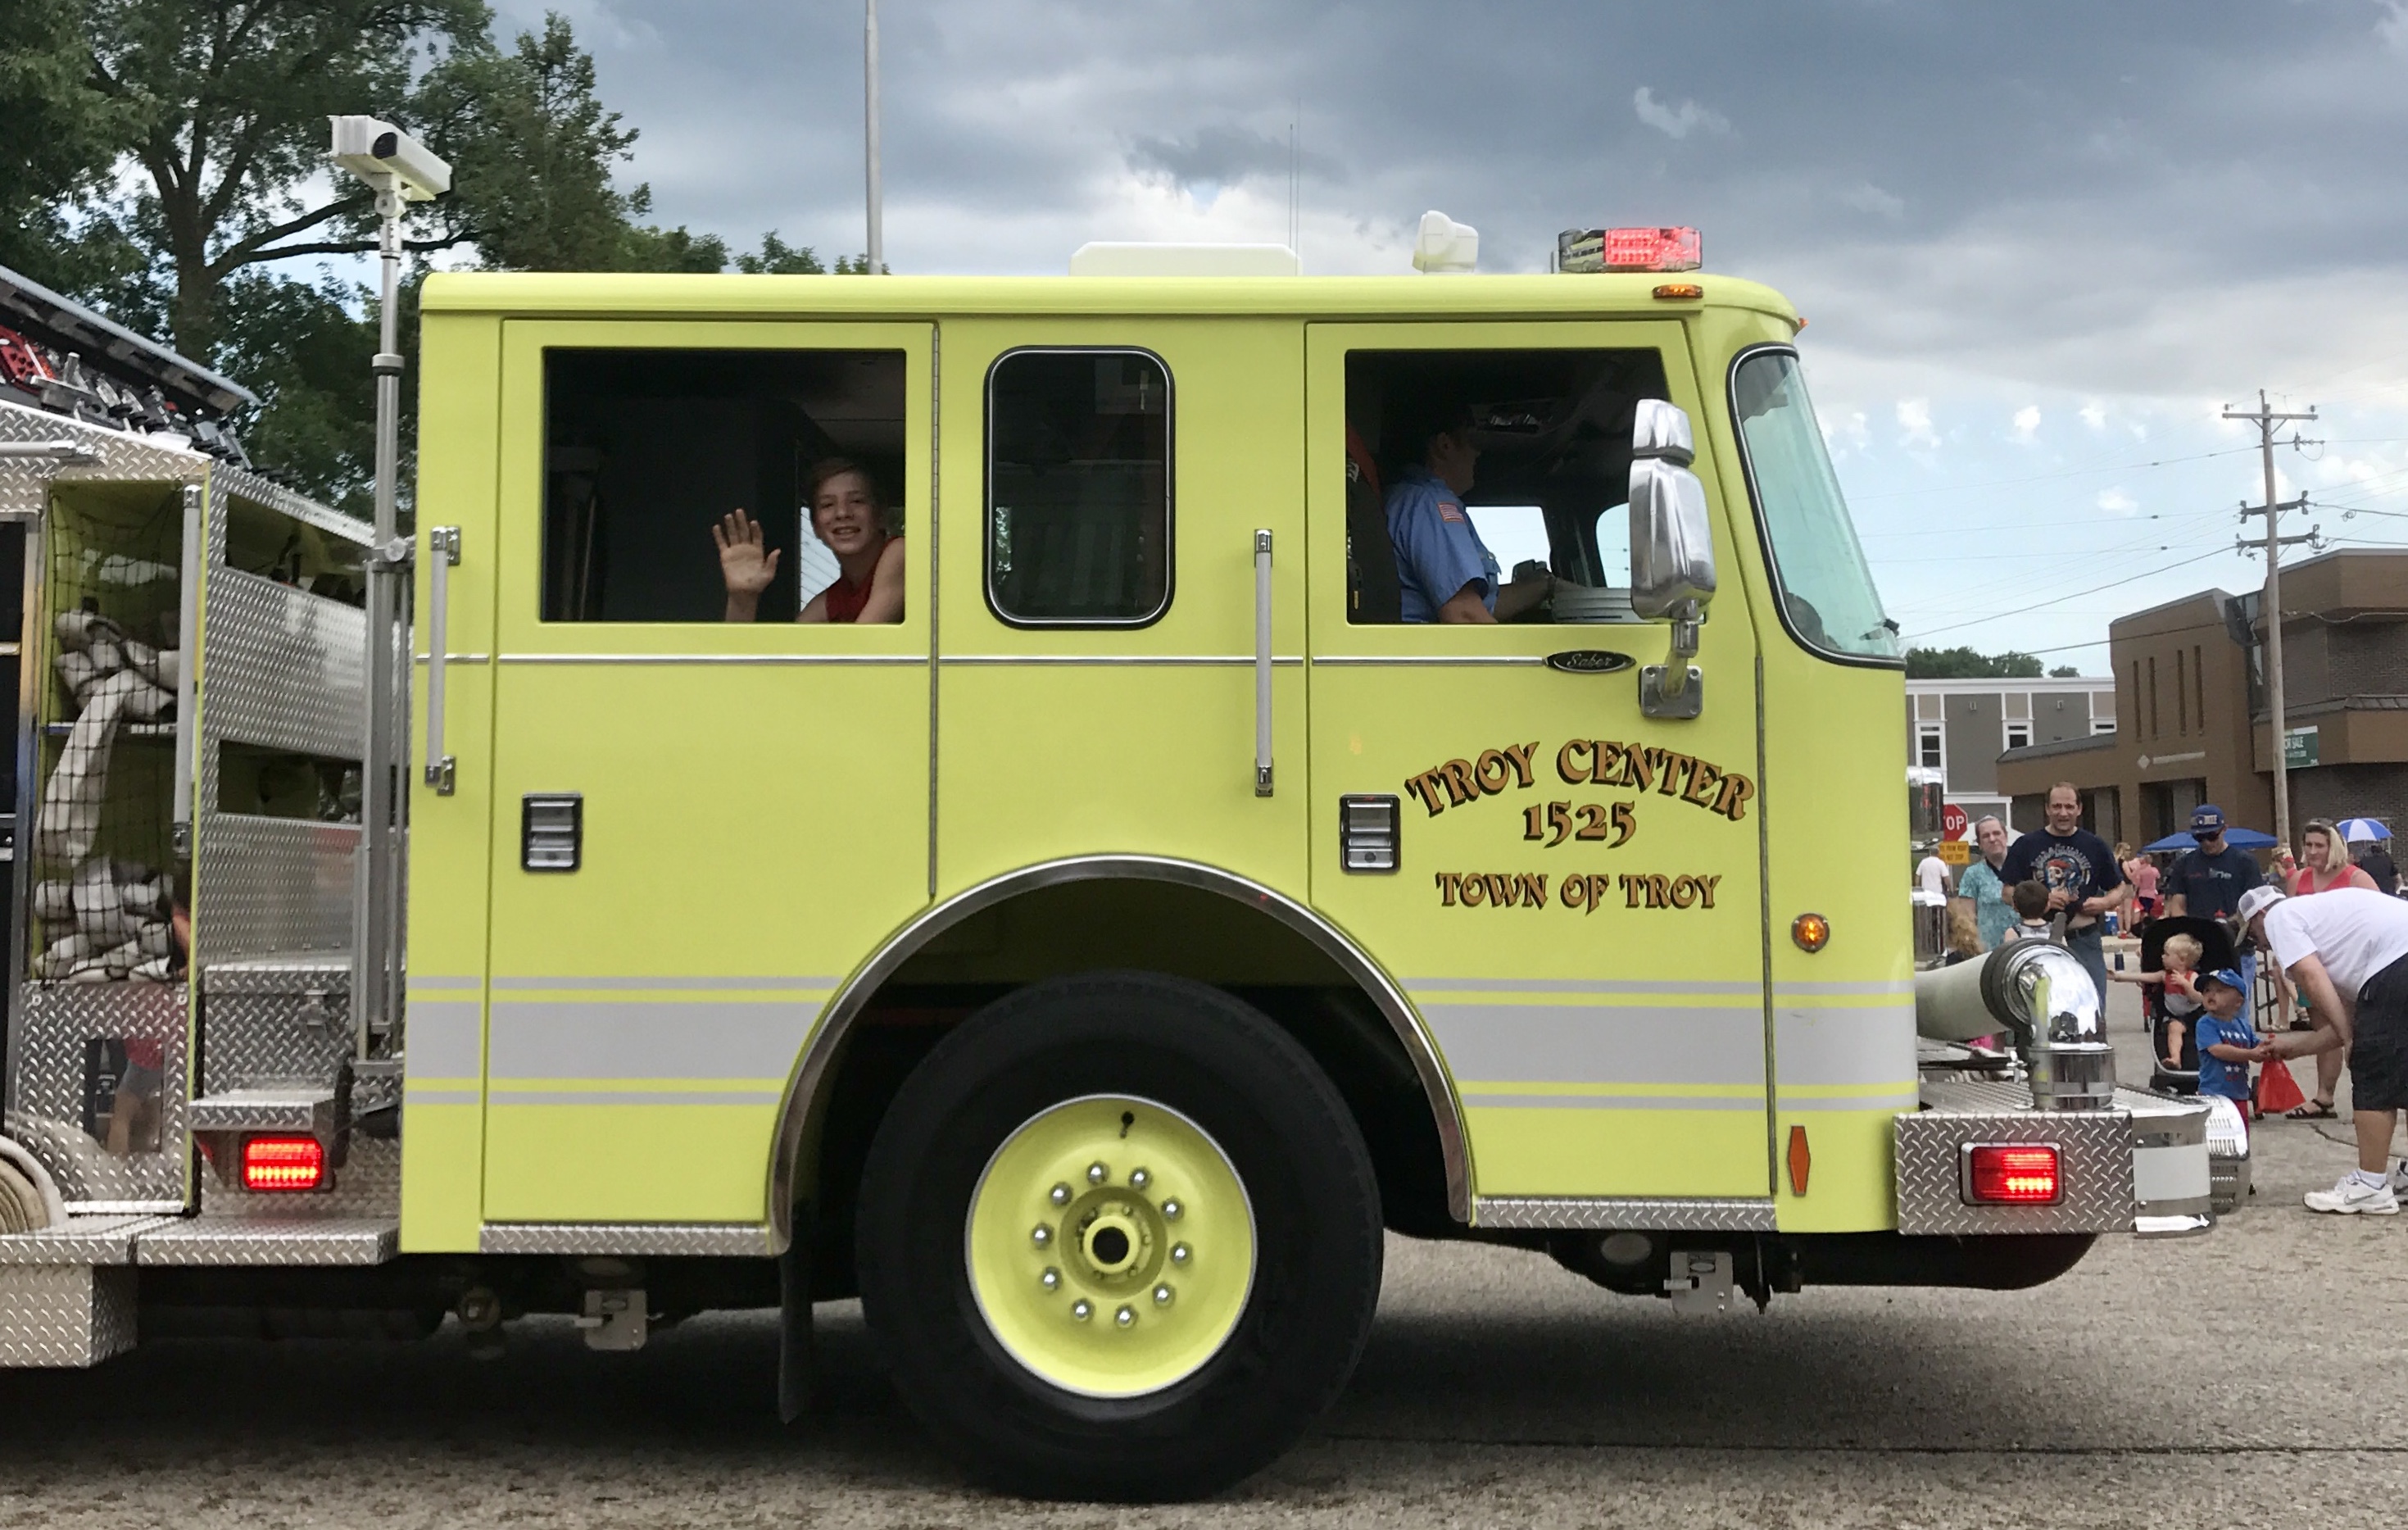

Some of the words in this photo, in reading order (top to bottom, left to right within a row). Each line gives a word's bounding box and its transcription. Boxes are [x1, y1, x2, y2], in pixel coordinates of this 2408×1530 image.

[1404, 741, 1540, 818] TROY
[1557, 738, 1755, 821] CENTER
[1523, 799, 1637, 848] 1525
[1944, 815, 1965, 830] OP
[1435, 871, 1549, 910] TOWN
[1560, 873, 1611, 916] OF
[1619, 874, 1722, 910] TROY
